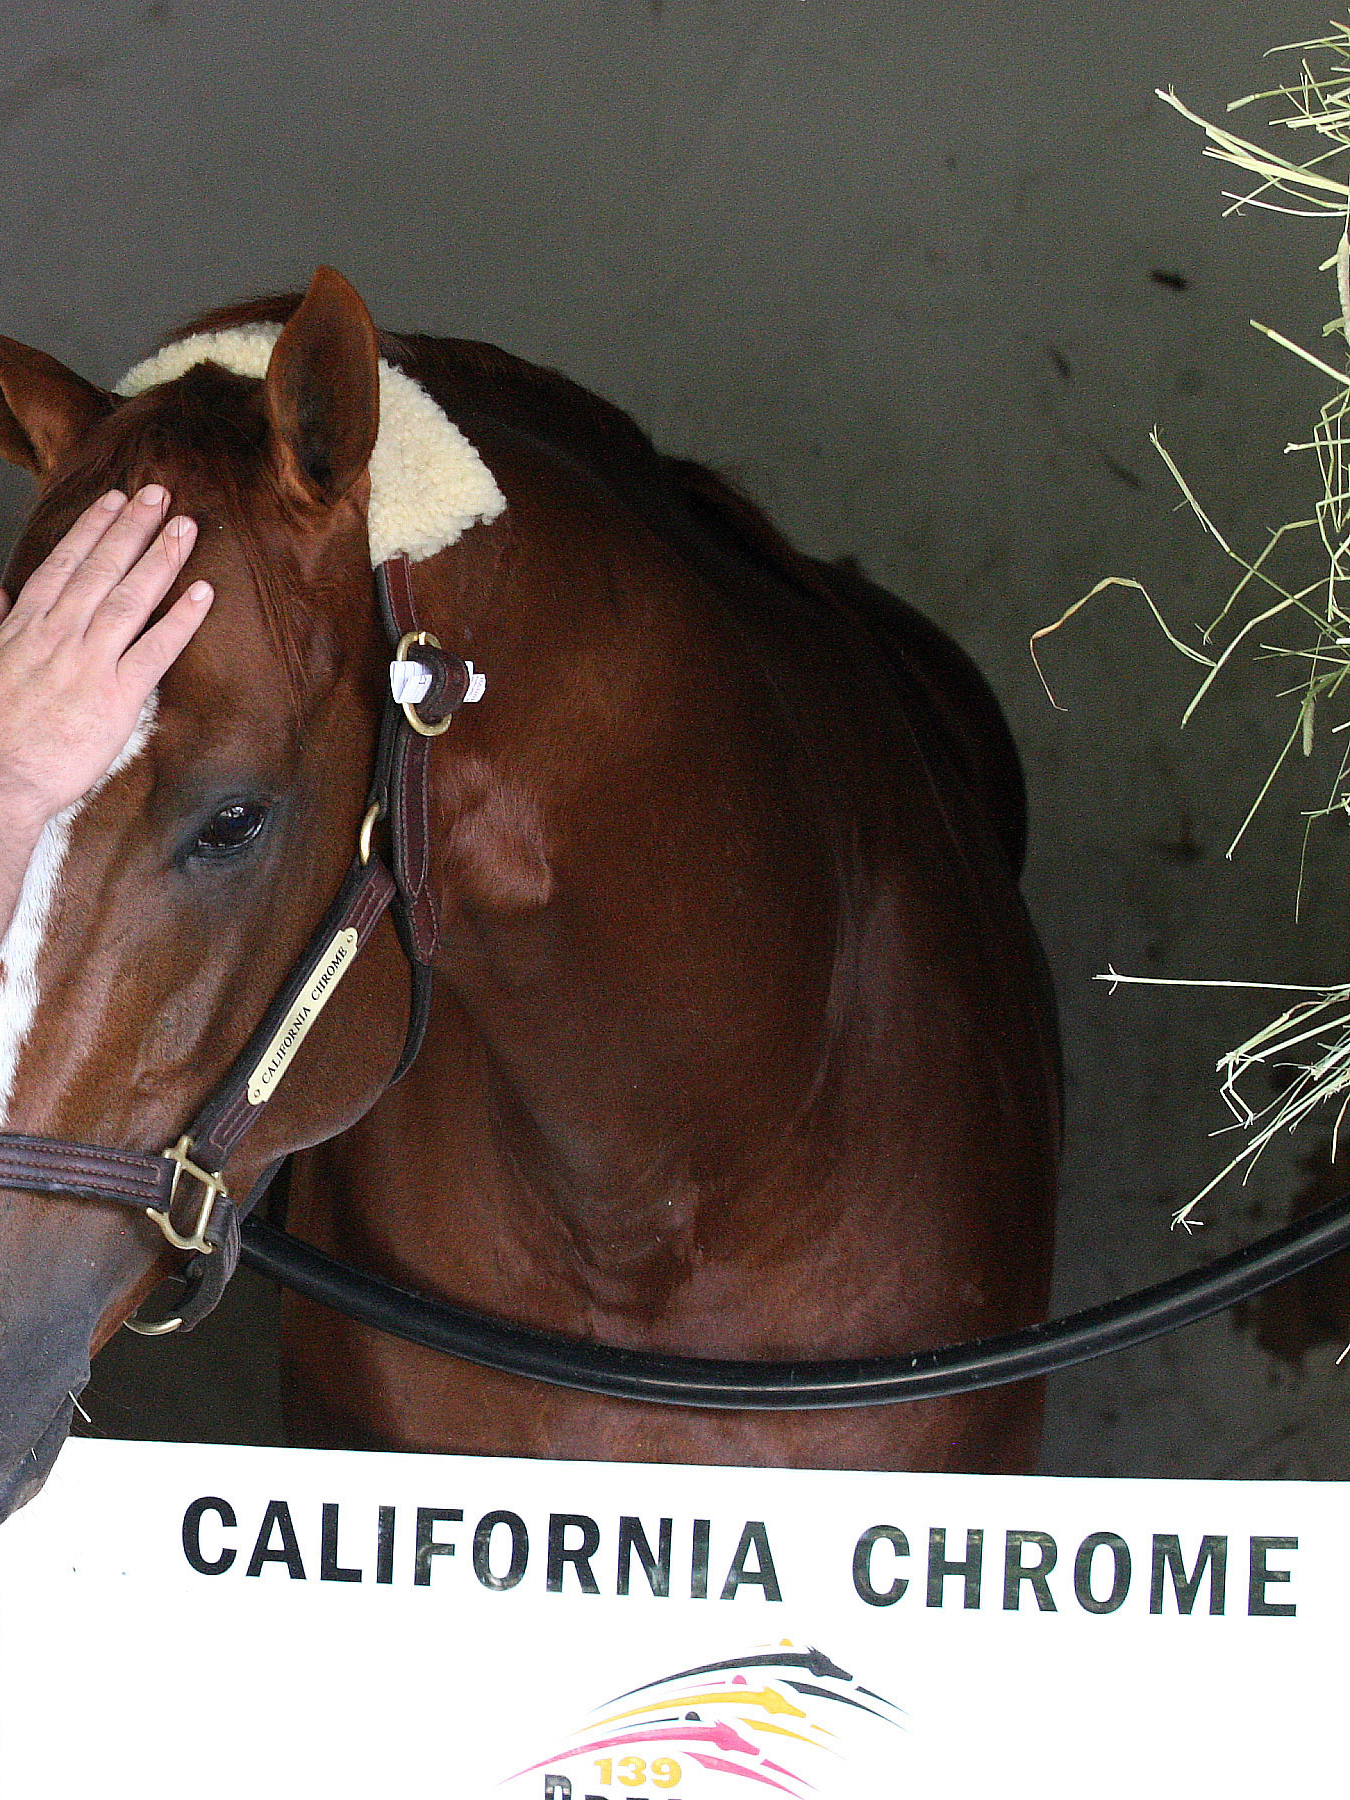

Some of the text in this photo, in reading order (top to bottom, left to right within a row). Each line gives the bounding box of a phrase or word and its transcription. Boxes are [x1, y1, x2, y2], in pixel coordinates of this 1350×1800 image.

[262, 946, 347, 1084] CALIFORNIA CHROME
[181, 1496, 1299, 1617] CALIFORNIA CHROME
[594, 1756, 682, 1788] 139
